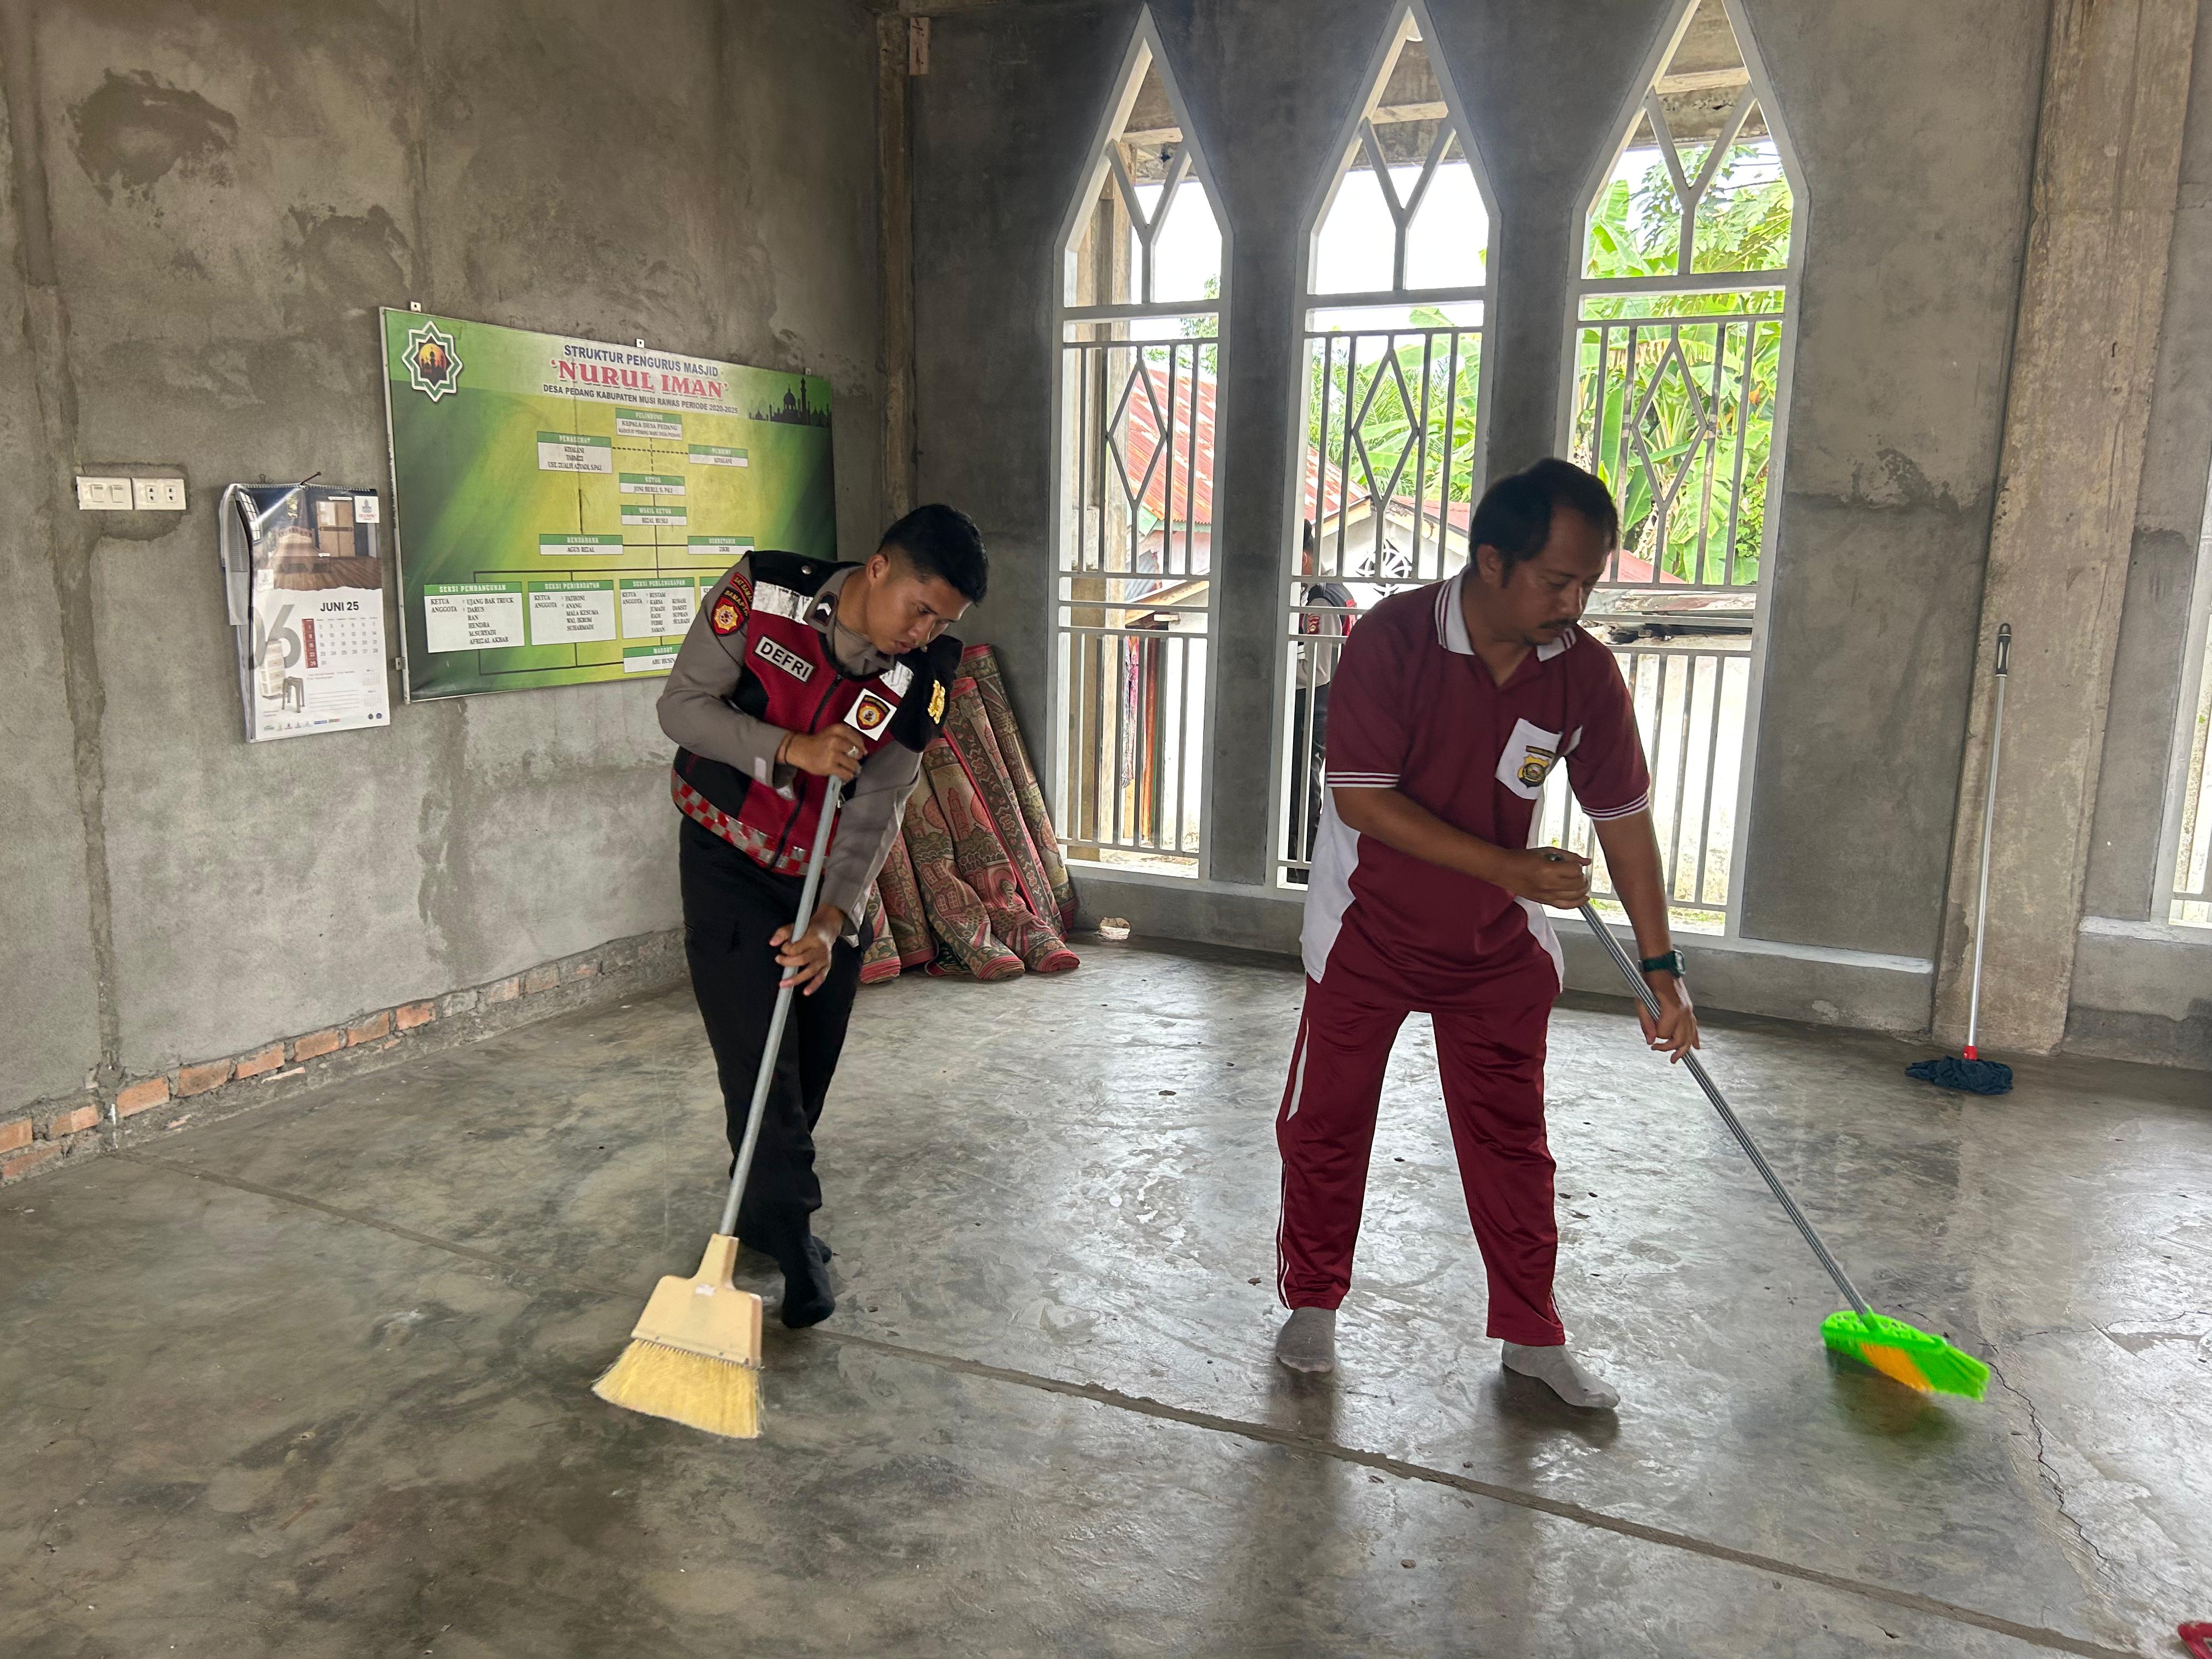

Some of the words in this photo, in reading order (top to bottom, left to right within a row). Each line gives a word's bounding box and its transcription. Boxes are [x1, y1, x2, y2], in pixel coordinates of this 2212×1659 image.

[565, 345, 623, 363] STRUKTUR
[627, 354, 681, 371] PENGURUS
[684, 362, 718, 376] MASJID
[544, 385, 563, 394] DESA
[566, 388, 594, 398] PEDANG
[596, 391, 637, 403] KABUPATEN
[640, 395, 655, 404] MUSI
[658, 398, 680, 407] RAWAS
[682, 400, 707, 410] PERIODE
[710, 404, 738, 414] 2020-2025
[320, 602, 345, 612] JUNI
[347, 601, 359, 611] 25
[760, 642, 809, 678] DEFRI
